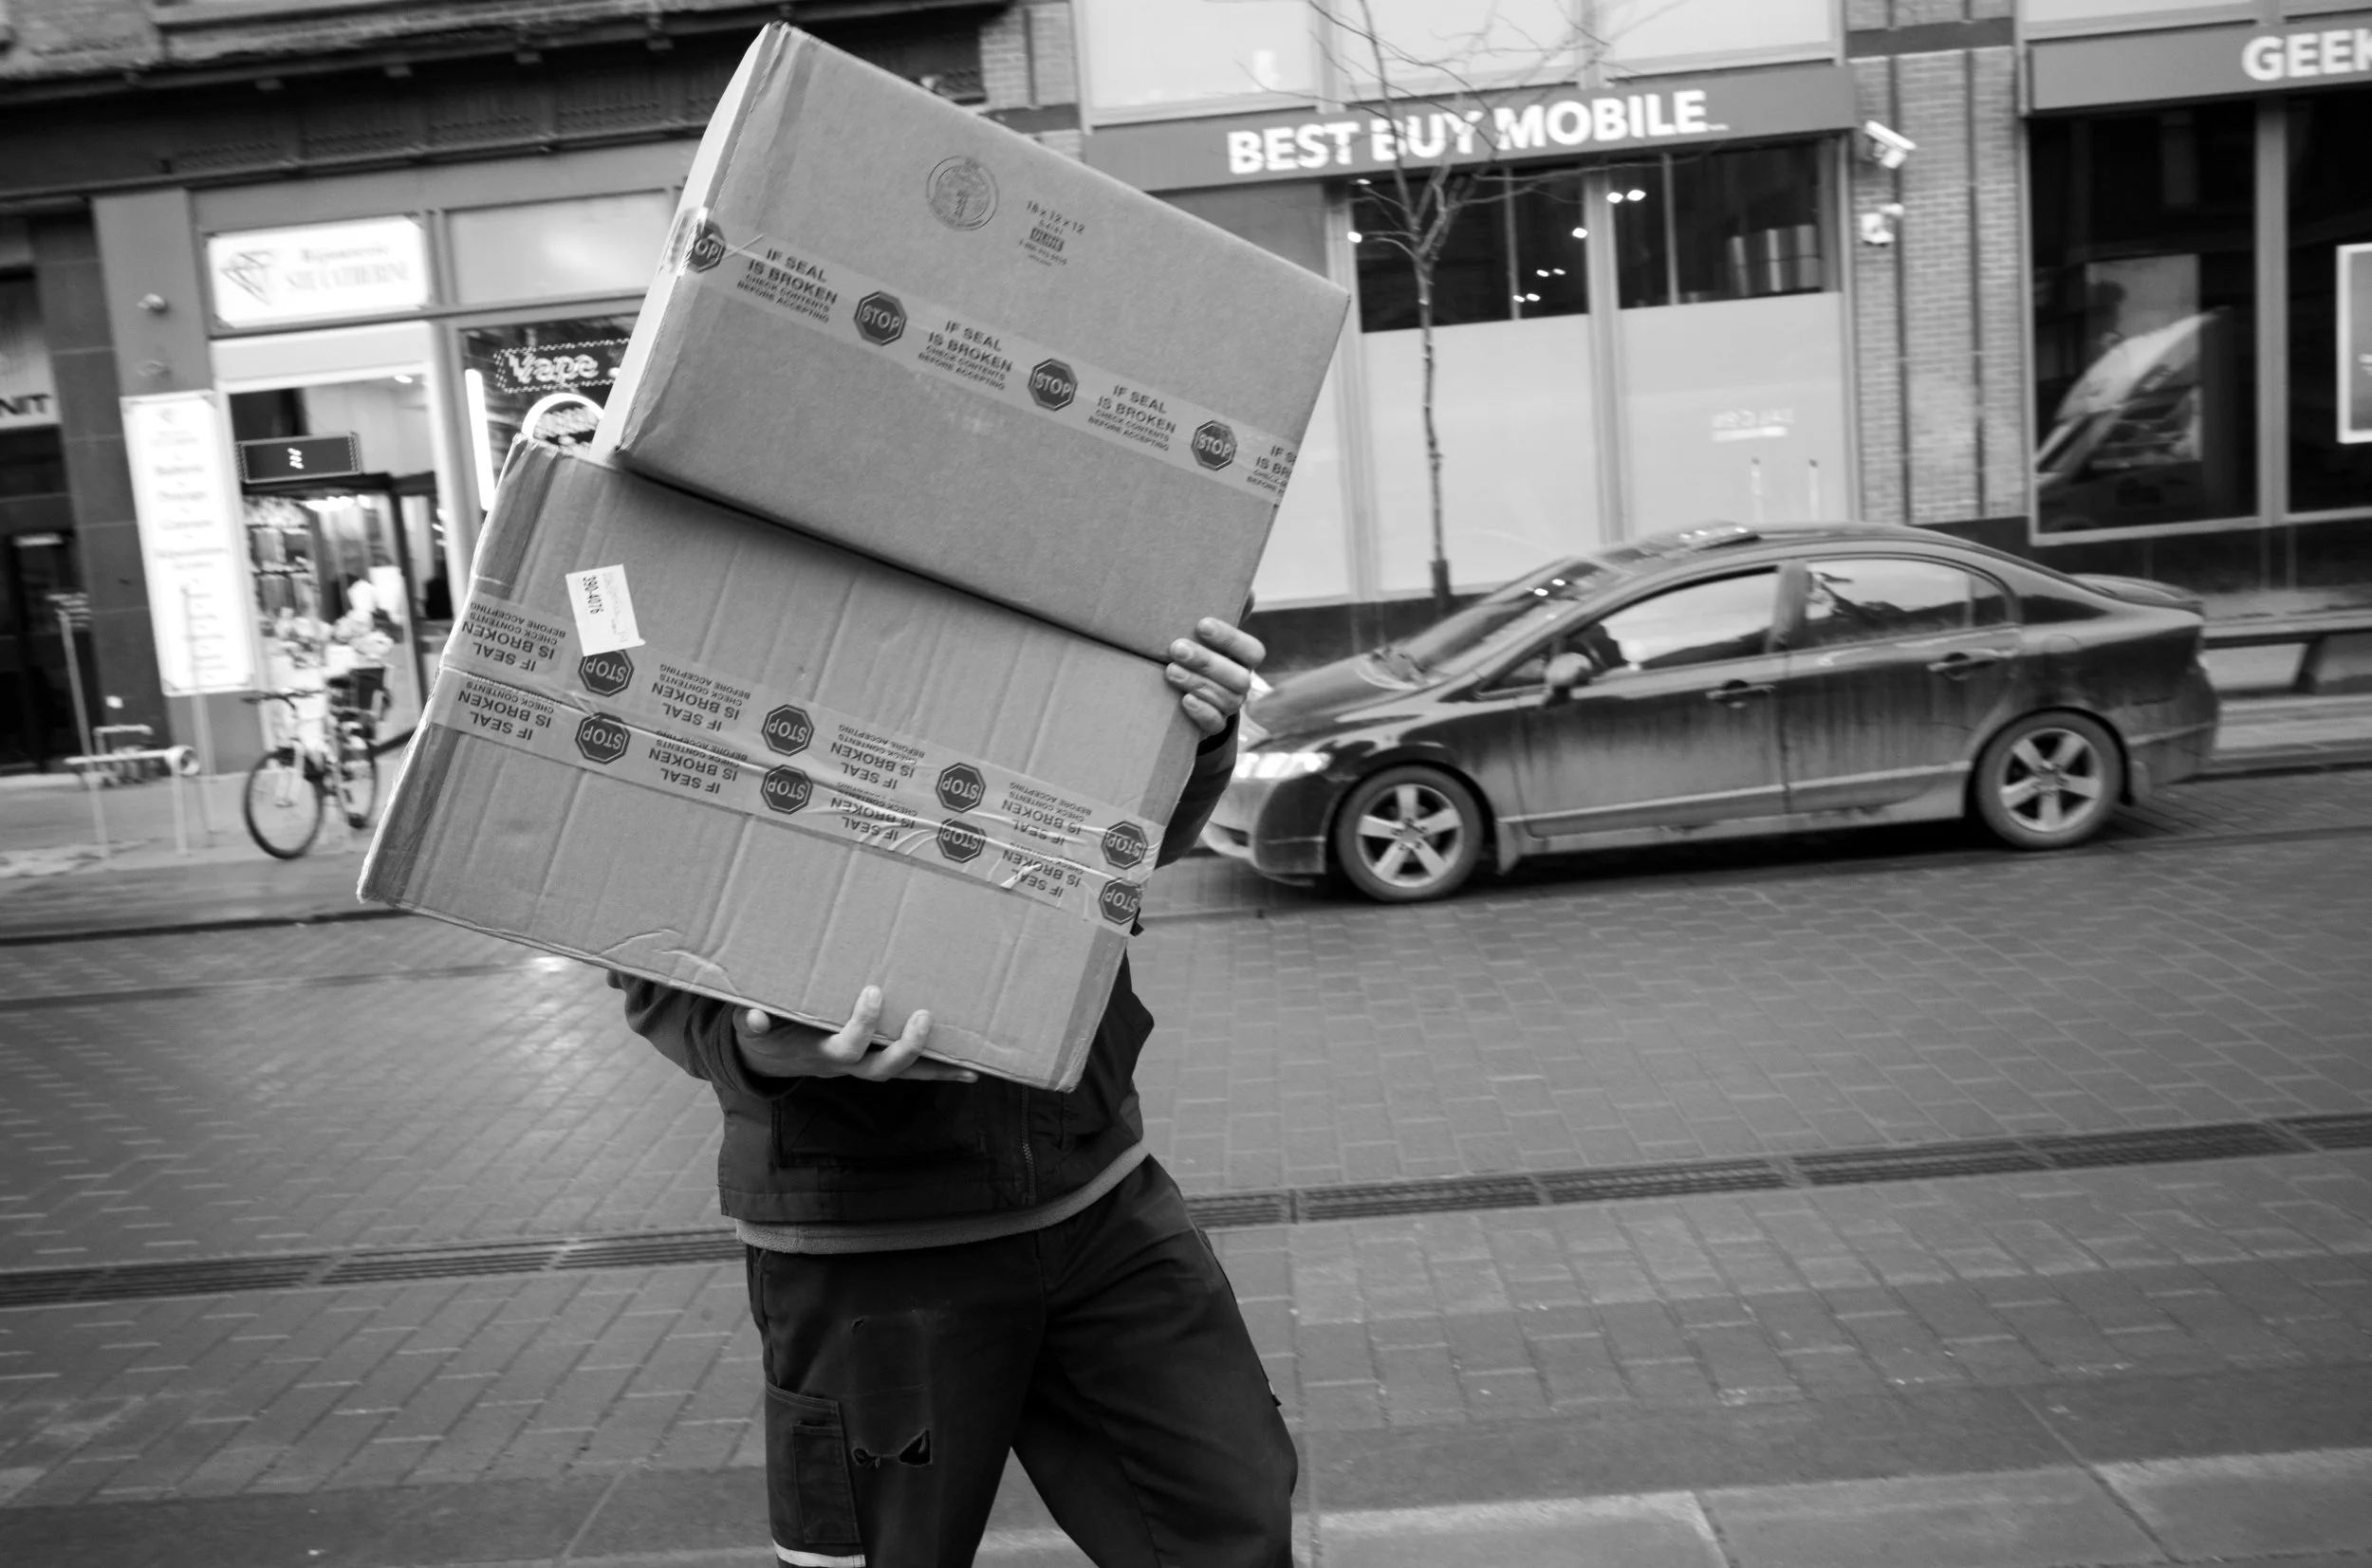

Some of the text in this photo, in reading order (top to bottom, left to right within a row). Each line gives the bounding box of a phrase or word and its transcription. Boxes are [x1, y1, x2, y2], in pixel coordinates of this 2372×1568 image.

[1227, 89, 1707, 175] BEST BUY MOBILE
[695, 237, 719, 260] OP
[766, 248, 827, 284] IF SEAL
[746, 273, 779, 293] CHECK
[748, 259, 839, 305] IS BROKEN
[862, 304, 901, 333] STOP
[945, 320, 1002, 353] IF SEAL
[925, 344, 957, 362] CHECK
[928, 331, 1013, 373] IS BROKEN
[505, 352, 600, 386] Vape
[1034, 371, 1072, 397] STOP
[1113, 384, 1168, 415] IF SEAL
[1094, 409, 1124, 424] CHECK
[1097, 396, 1177, 434] IS BROKEN
[1196, 434, 1232, 459] STOP
[1269, 445, 1286, 458] IF
[1255, 456, 1269, 470] IS
[461, 620, 555, 661] IS BROKEN
[523, 629, 558, 646] CHECK
[473, 642, 537, 673] IF SEAL
[585, 657, 627, 684] STOP
[457, 691, 552, 729] IS BROKEN
[521, 695, 555, 714] CHECK
[651, 682, 740, 721] IS BROKEN
[712, 690, 743, 707] CHECK
[470, 710, 533, 741] IF SEAL
[661, 703, 722, 732] IF SEAL
[582, 726, 624, 751] STOP
[768, 718, 807, 744] STOP
[648, 747, 738, 782] IS BROKEN
[829, 742, 915, 779] IS BROKEN
[659, 767, 721, 795] IF SEAL
[767, 776, 806, 801] STOP
[840, 762, 898, 790] IF SEAL
[941, 776, 980, 801] STOP
[830, 797, 897, 823] BROKEN
[1001, 800, 1082, 836] IS BROKEN
[841, 816, 899, 841] IF SEAL
[942, 828, 980, 850] STOP
[1011, 819, 1065, 846] IF SEAL
[1106, 832, 1143, 858] STOP
[1048, 887, 1064, 898] IF
[1066, 875, 1082, 888] IS
[1104, 888, 1139, 913] STOP
